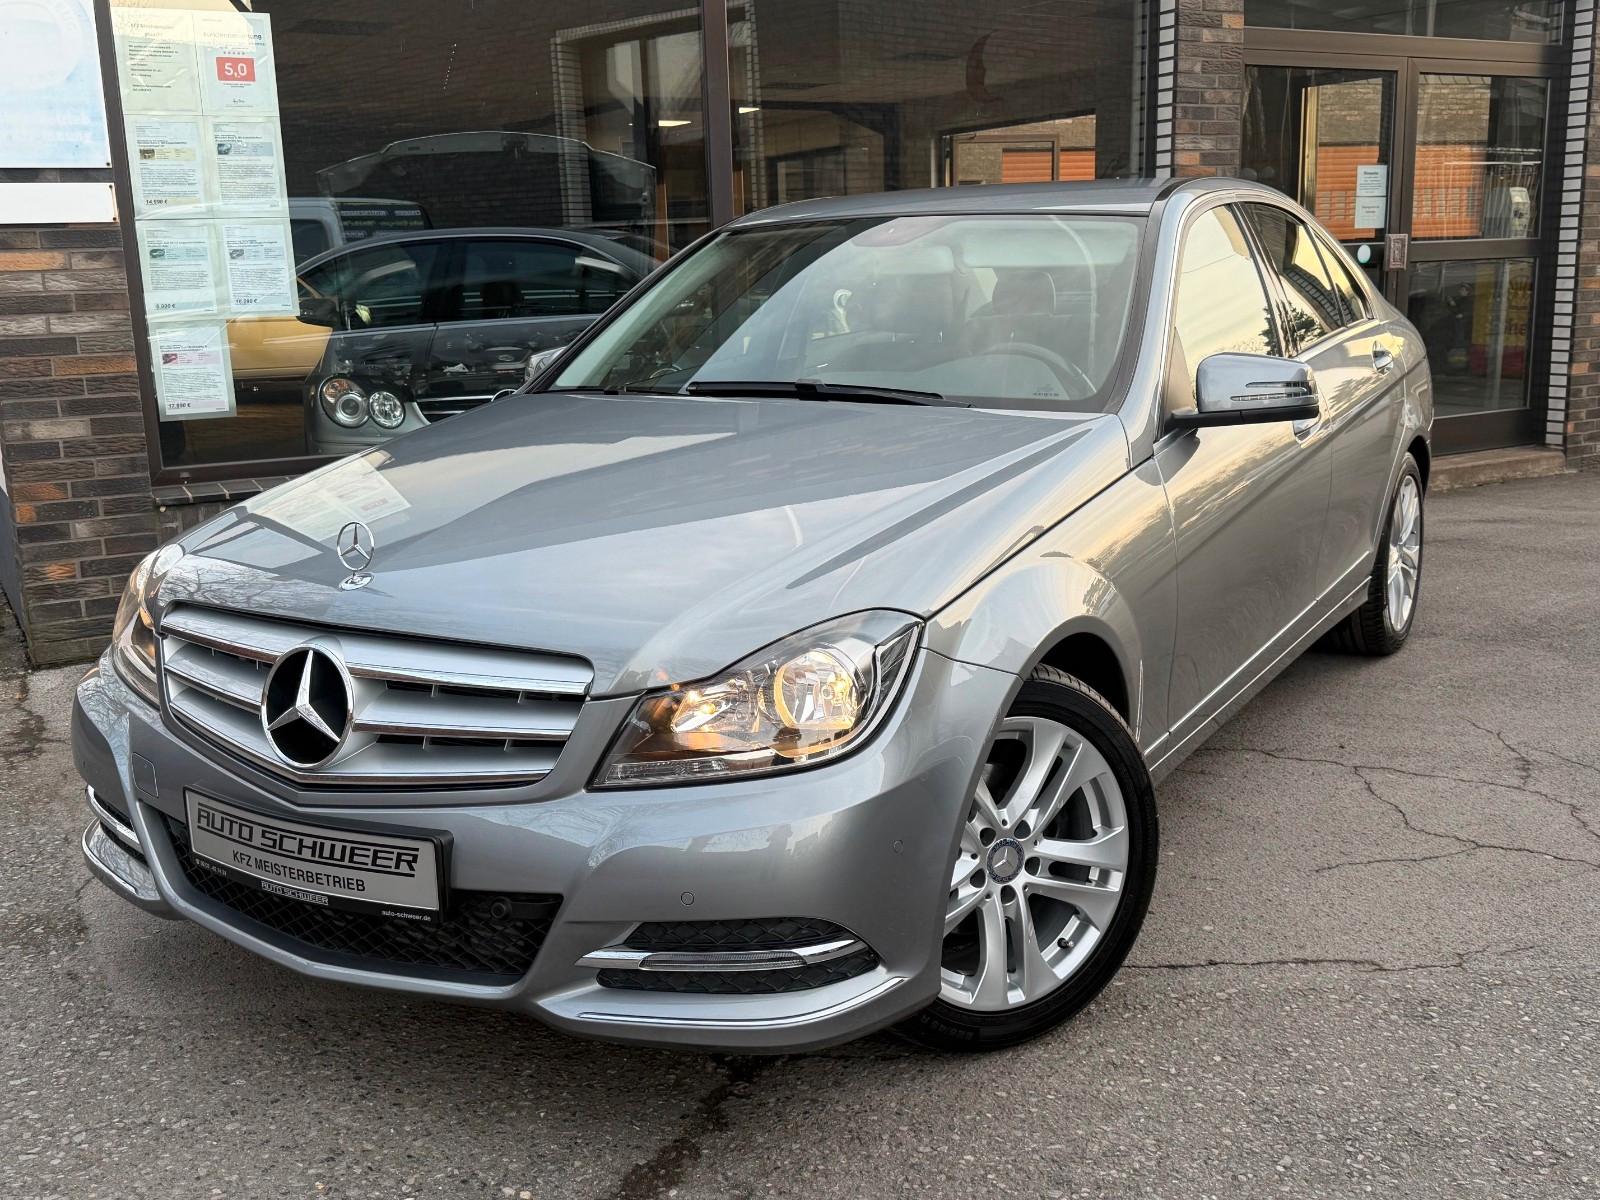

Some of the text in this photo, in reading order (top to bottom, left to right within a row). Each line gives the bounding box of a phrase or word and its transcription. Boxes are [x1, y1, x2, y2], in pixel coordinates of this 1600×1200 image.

[224, 62, 248, 78] 5,0
[198, 807, 254, 842] AUTO
[260, 829, 420, 872] SCHWEER
[232, 849, 252, 867] KFZ
[254, 857, 366, 892] MEISTERBETRIEB
[261, 880, 329, 906] AUTO SCHWEER
[381, 909, 432, 922] auto-schweer.de
